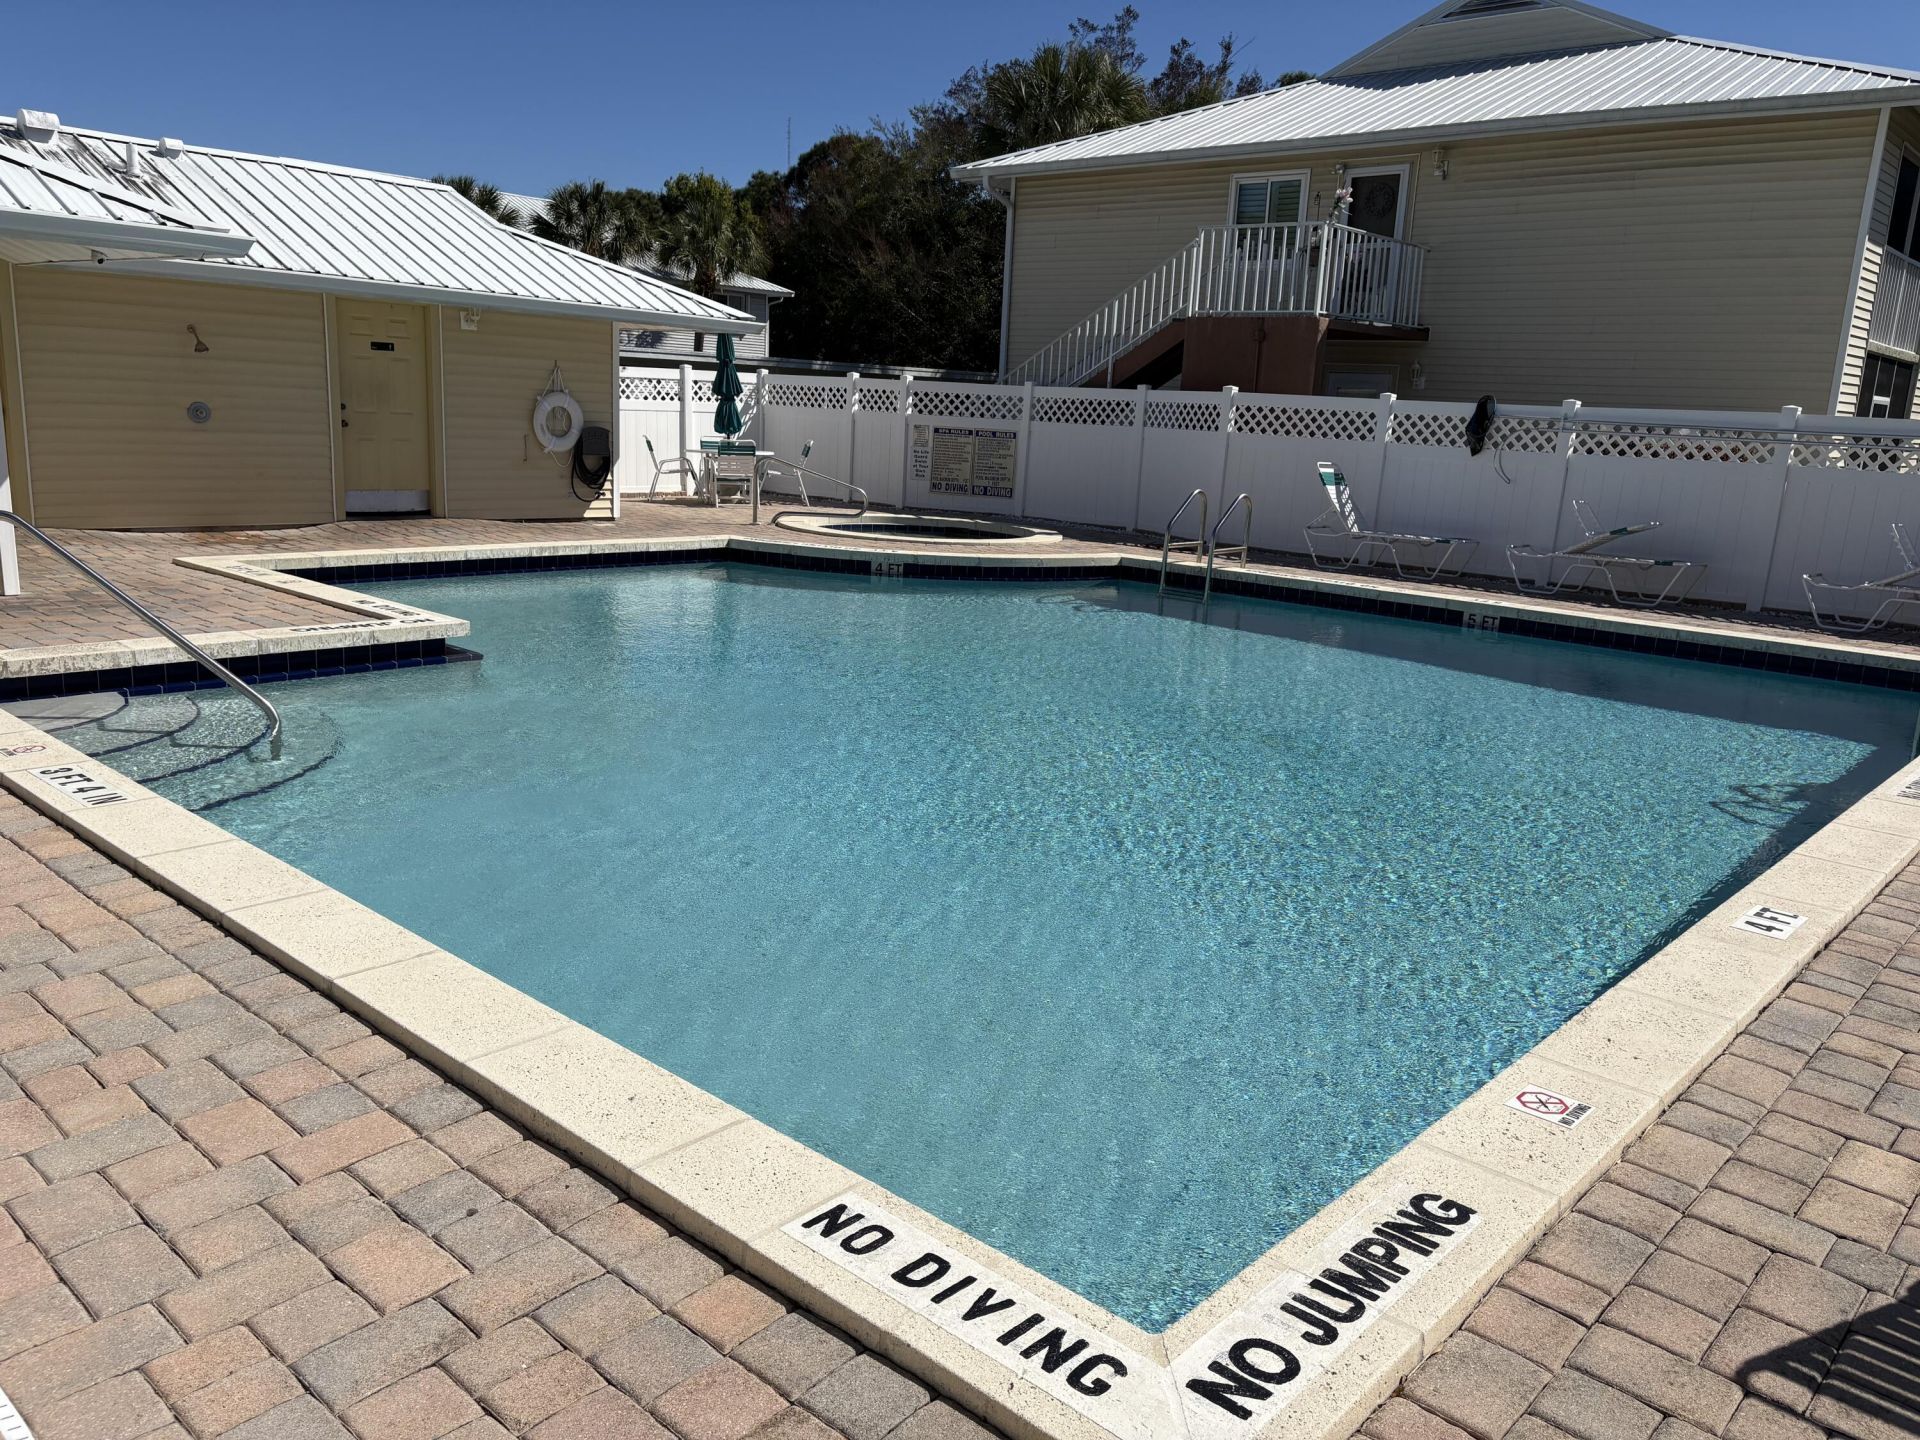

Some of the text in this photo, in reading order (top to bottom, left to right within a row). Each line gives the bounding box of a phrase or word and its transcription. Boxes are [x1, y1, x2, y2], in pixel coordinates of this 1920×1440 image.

[932, 482, 968, 492] NO DIVING
[973, 486, 1011, 497] NO DIVING
[875, 563, 902, 576] 4 FT
[1468, 614, 1498, 629] 5 FT
[39, 767, 74, 775] 3
[49, 773, 95, 786] FT
[81, 792, 128, 806] IN
[1744, 907, 1800, 933] 4 FT
[1558, 1103, 1592, 1126] NO DIVING
[801, 1203, 1129, 1397] NO DIVING
[1186, 1192, 1479, 1421] NO JUMPING
